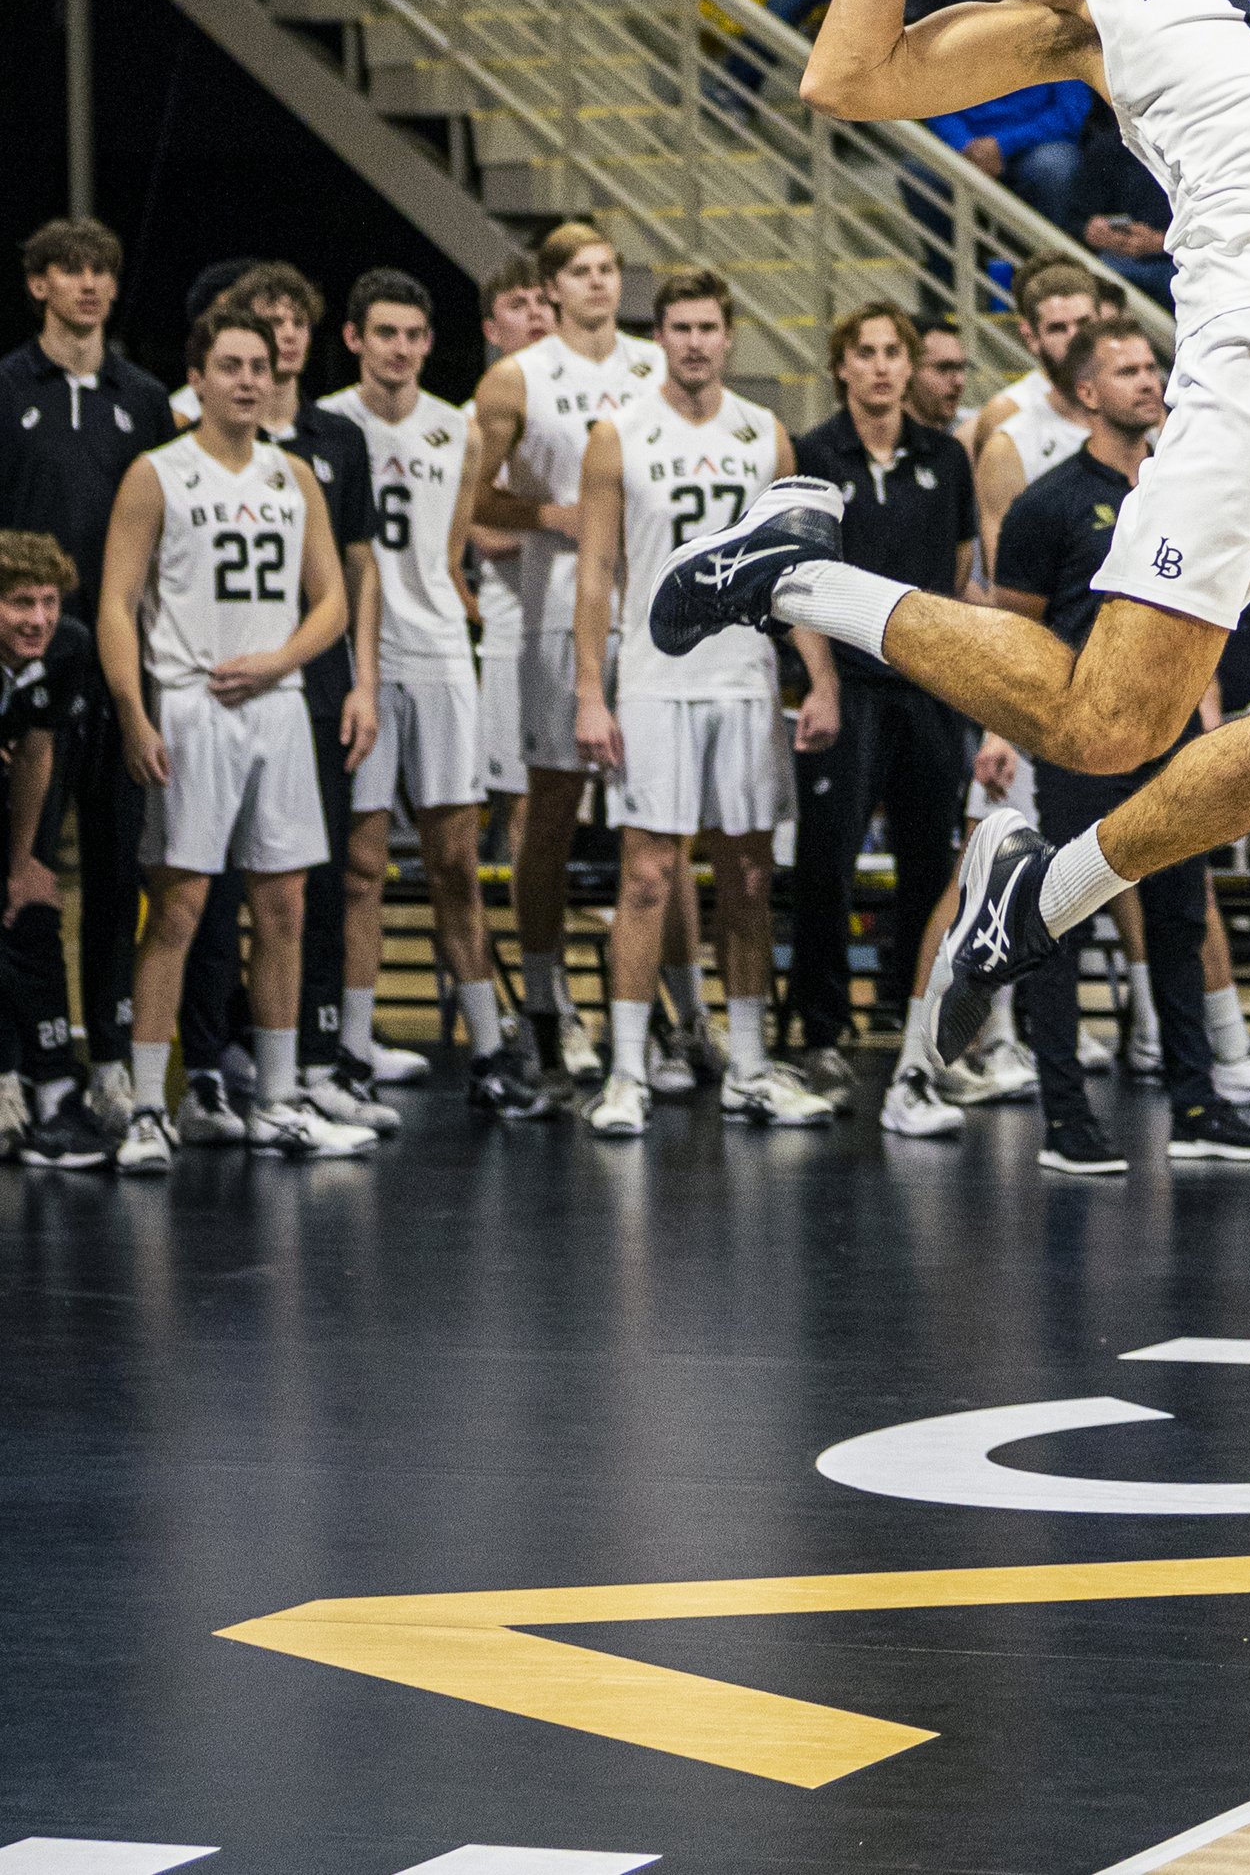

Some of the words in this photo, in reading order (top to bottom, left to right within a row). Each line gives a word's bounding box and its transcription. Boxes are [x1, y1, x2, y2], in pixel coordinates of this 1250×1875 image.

[382, 455, 444, 485] ACH
[650, 456, 758, 482] BEACH
[190, 503, 297, 526] BEACH
[379, 485, 412, 550] 6
[670, 483, 746, 550] 27
[213, 531, 286, 602] 22
[1150, 536, 1183, 580] LB
